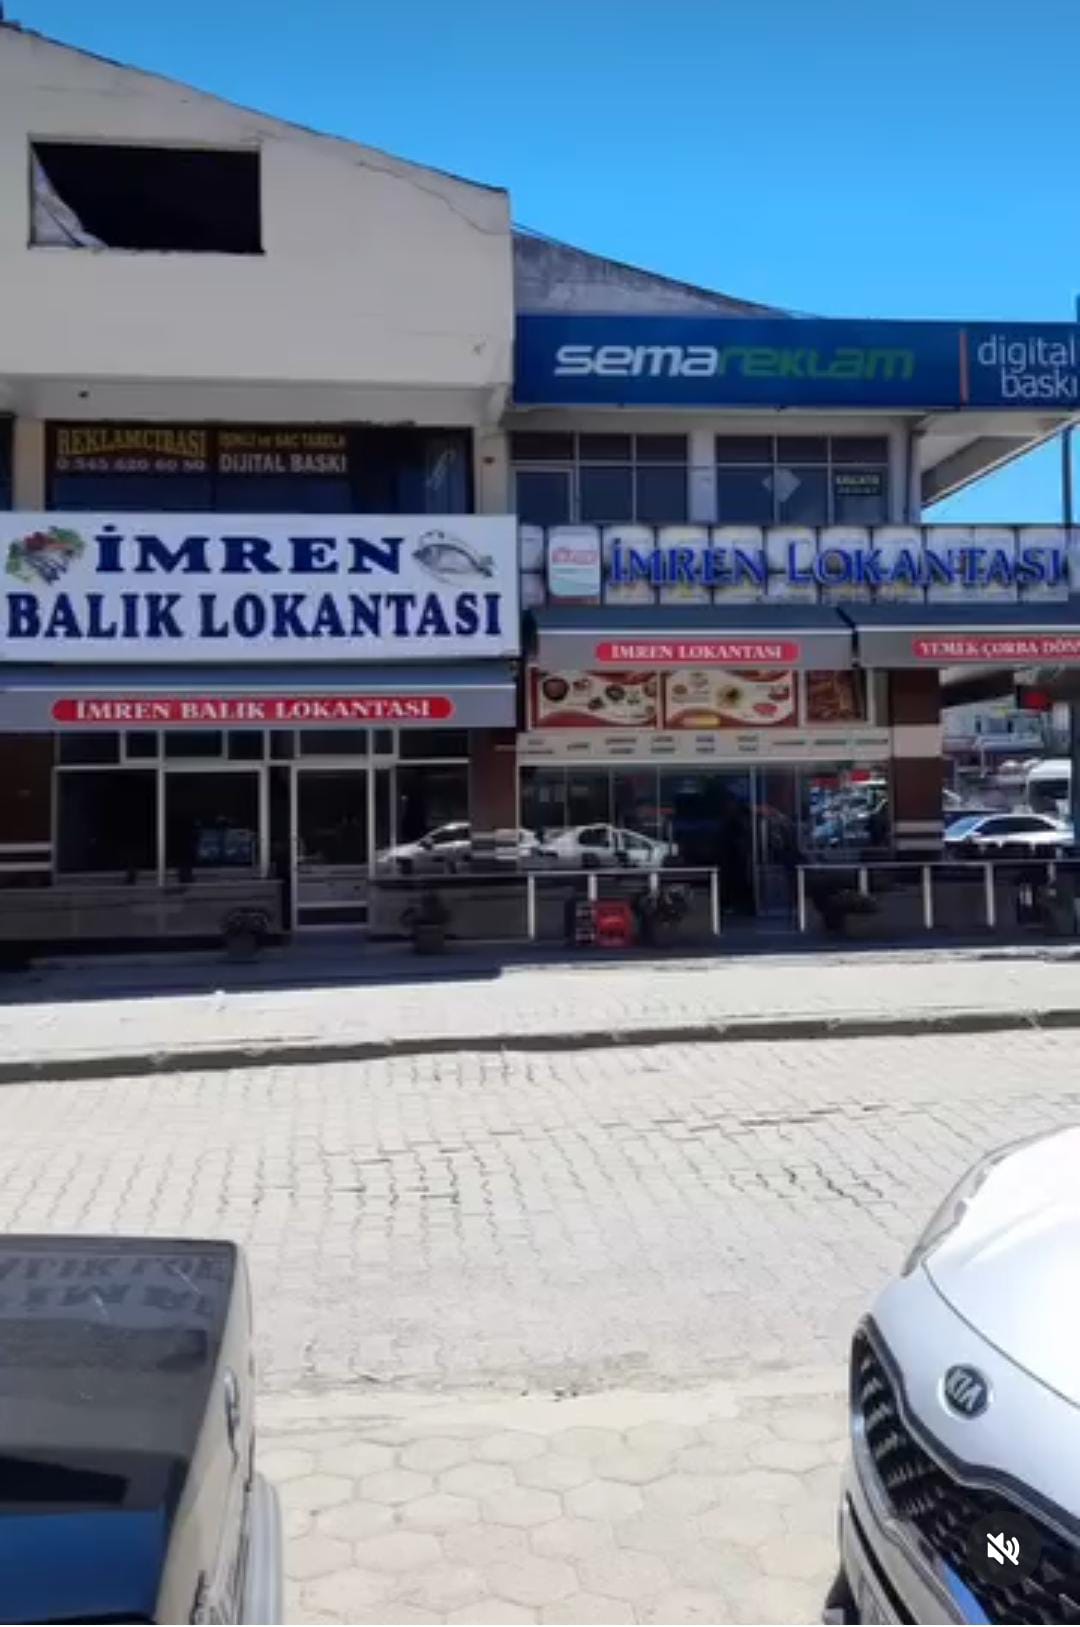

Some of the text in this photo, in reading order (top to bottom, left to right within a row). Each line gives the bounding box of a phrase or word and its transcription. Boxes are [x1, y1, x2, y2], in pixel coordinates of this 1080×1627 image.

[977, 334, 1076, 374] digital
[94, 525, 404, 574] İMREN
[608, 537, 768, 588] İMREN
[787, 540, 1063, 588] LOKANTASI
[6, 592, 502, 638] BALIK LOKANTASI
[678, 644, 782, 660] LOKANTASI
[181, 702, 265, 719] BALIK
[274, 700, 430, 718] LOKANTASI
